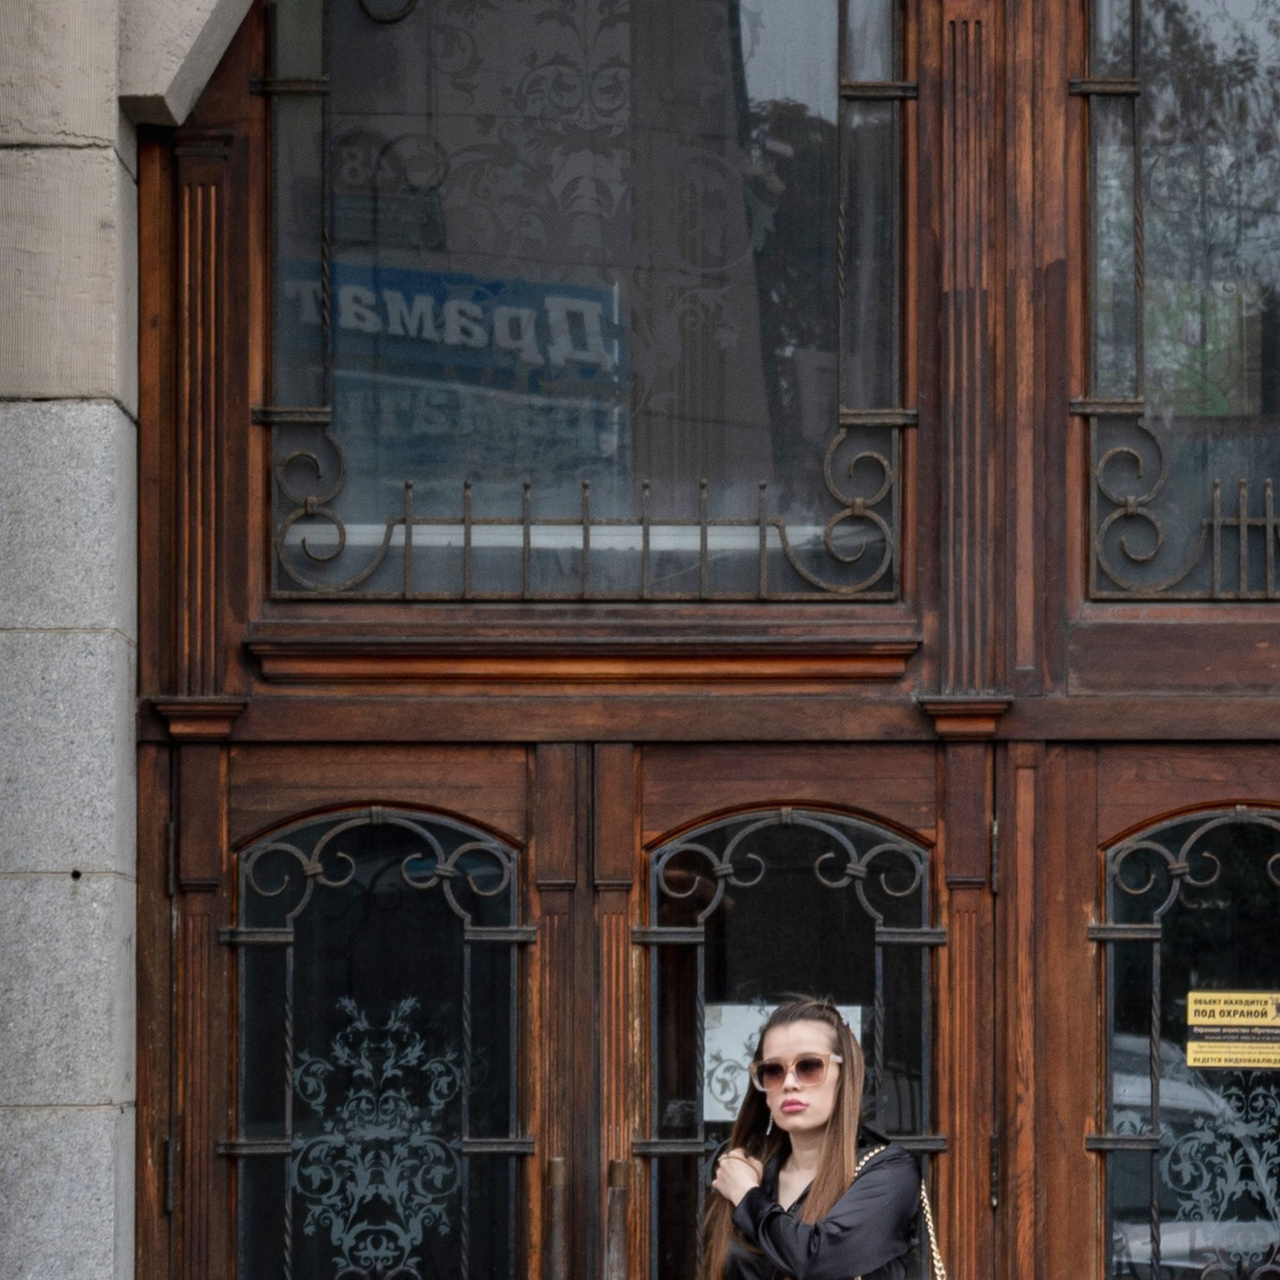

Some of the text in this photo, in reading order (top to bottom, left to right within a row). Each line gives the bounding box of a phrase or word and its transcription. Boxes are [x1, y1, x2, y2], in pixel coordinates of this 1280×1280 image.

[1223, 999, 1269, 1007] НАХОДИТСЯ
[1193, 1007, 1268, 1019] ПОД ОХРАНОЙ
